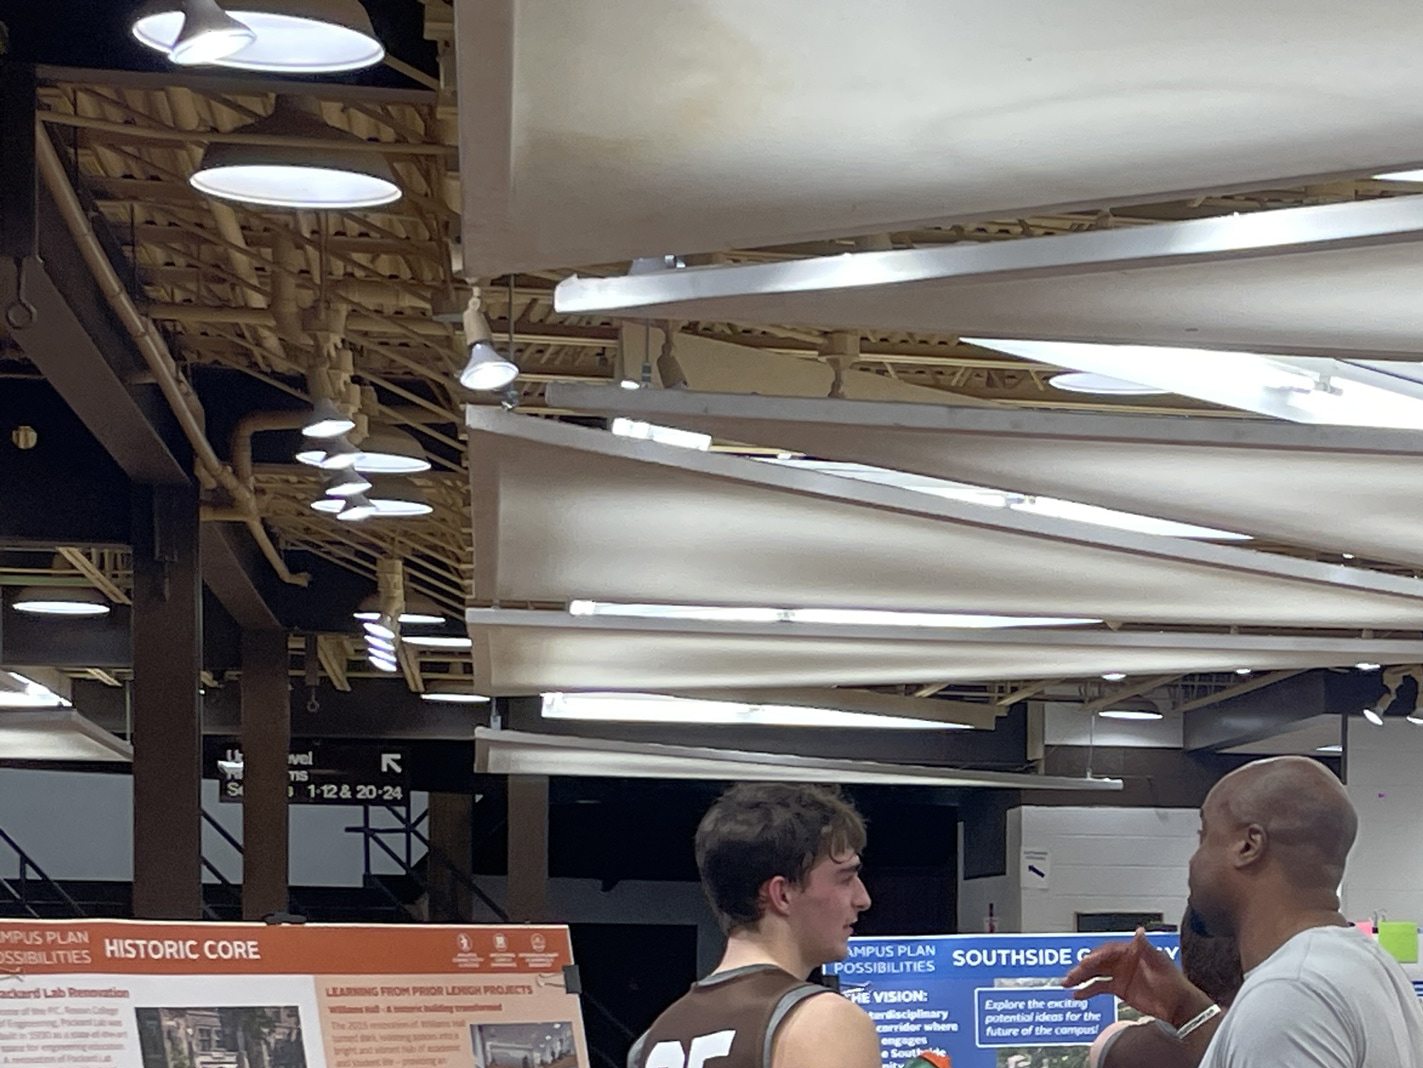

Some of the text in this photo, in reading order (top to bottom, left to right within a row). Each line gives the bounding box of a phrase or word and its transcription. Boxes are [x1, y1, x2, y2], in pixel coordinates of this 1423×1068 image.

[340, 785, 352, 798] &
[46, 931, 90, 944] PLAN
[104, 938, 261, 960] HISTORIC CORE
[846, 945, 935, 958] AMPUS PLAN
[952, 948, 1072, 967] SOUTHSIDE
[834, 961, 936, 974] POSSIBILITIES
[325, 985, 533, 997] LEARNING FROM PRIOR LEHIGH PROJECTS
[873, 990, 928, 1003] VISION:
[985, 999, 1088, 1011] Explore the exciting
[985, 1011, 1101, 1024] potential ideas for the
[876, 1021, 958, 1033] corridor where
[986, 1025, 1099, 1037] future of the campus!
[881, 1036, 928, 1048] engages
